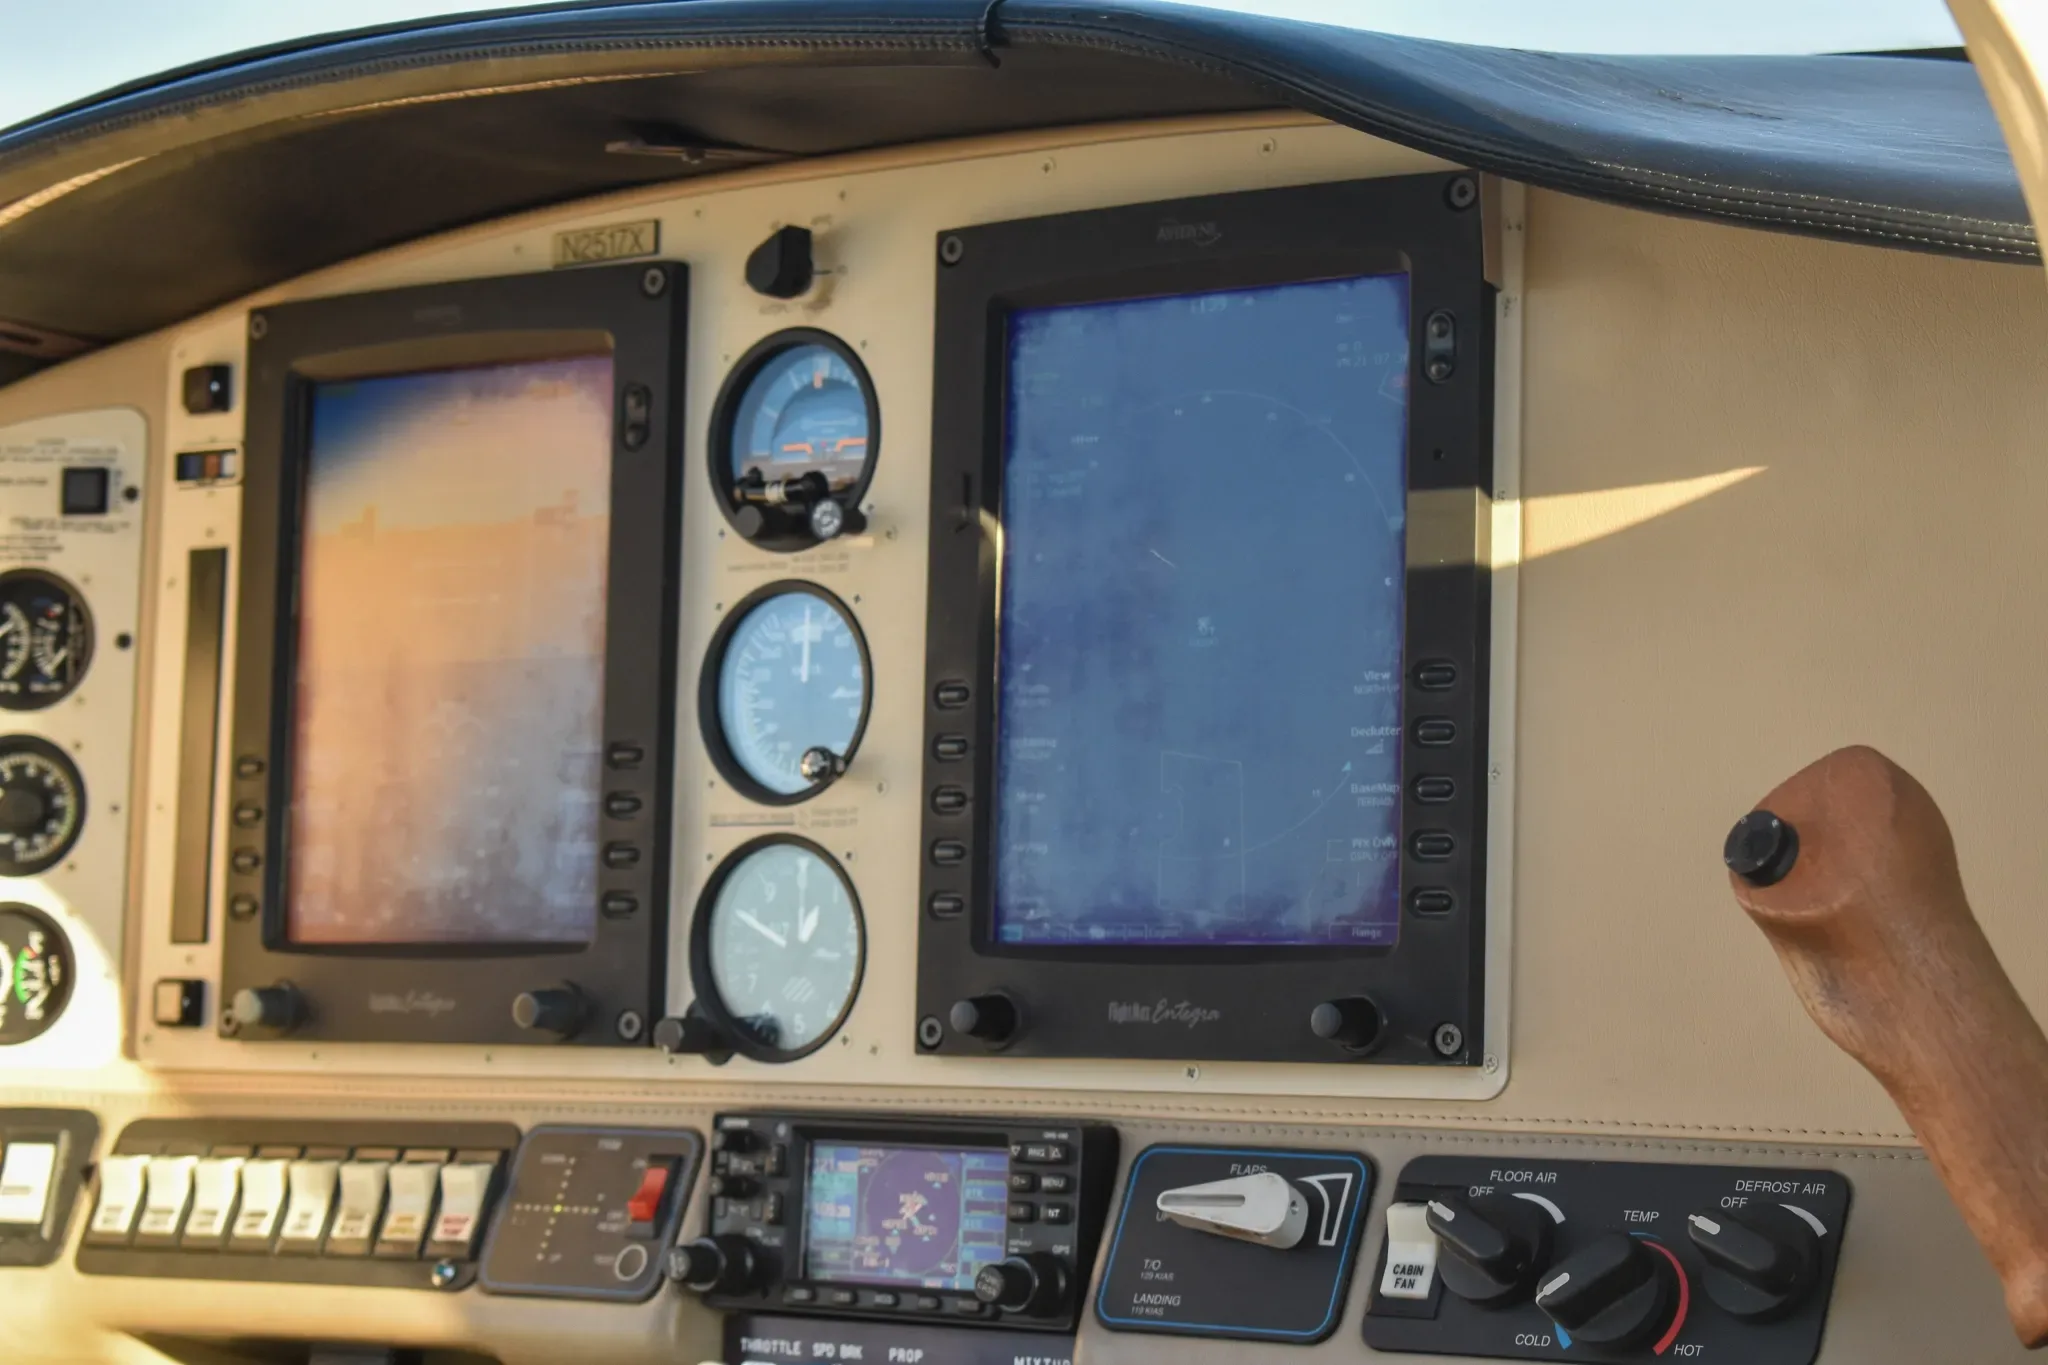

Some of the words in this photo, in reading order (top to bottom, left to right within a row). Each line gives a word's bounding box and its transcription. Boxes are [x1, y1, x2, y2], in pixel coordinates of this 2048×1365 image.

[562, 227, 645, 260] N2517X
[1363, 669, 1391, 681] View
[1350, 725, 1401, 738] Declutter
[1350, 782, 1400, 795] BaseMap
[1229, 1163, 1268, 1175] FLAPS
[1489, 1170, 1531, 1184] FLOOR
[1534, 1171, 1557, 1184] AIR
[1468, 1186, 1494, 1198] OFF
[1735, 1180, 1799, 1195] DEFROST
[1801, 1183, 1826, 1195] AIR
[1720, 1196, 1748, 1209] OFF
[1623, 1209, 1659, 1223] TEMP
[1154, 1272, 1175, 1282] KIAS
[1392, 1263, 1424, 1277] CABIN
[1394, 1277, 1416, 1290] FAN
[1133, 1292, 1182, 1307] LANDING
[1144, 1307, 1165, 1317] KIAS
[740, 1336, 802, 1356] THROTTLE
[1515, 1333, 1551, 1347] COLD
[812, 1341, 836, 1358] SPD
[888, 1346, 925, 1364] PROP
[1673, 1343, 1704, 1358] HOT
